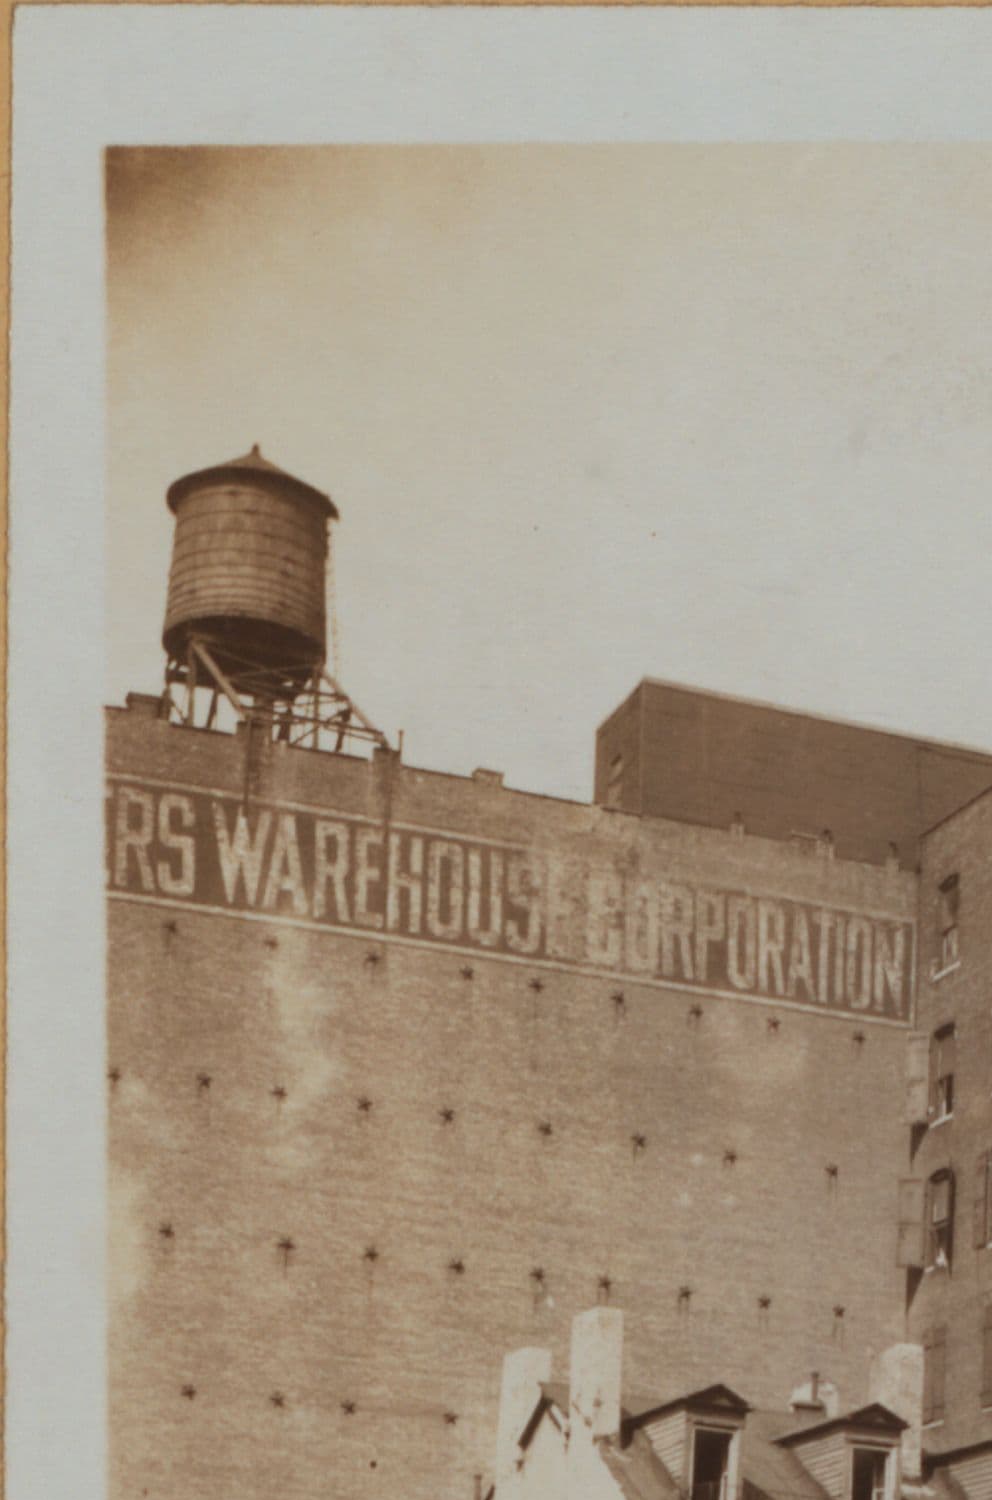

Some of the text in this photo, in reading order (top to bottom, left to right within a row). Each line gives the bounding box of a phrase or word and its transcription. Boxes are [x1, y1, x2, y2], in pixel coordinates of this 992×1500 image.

[108, 786, 906, 1018] RS WAREHOUSE CORPORATION
